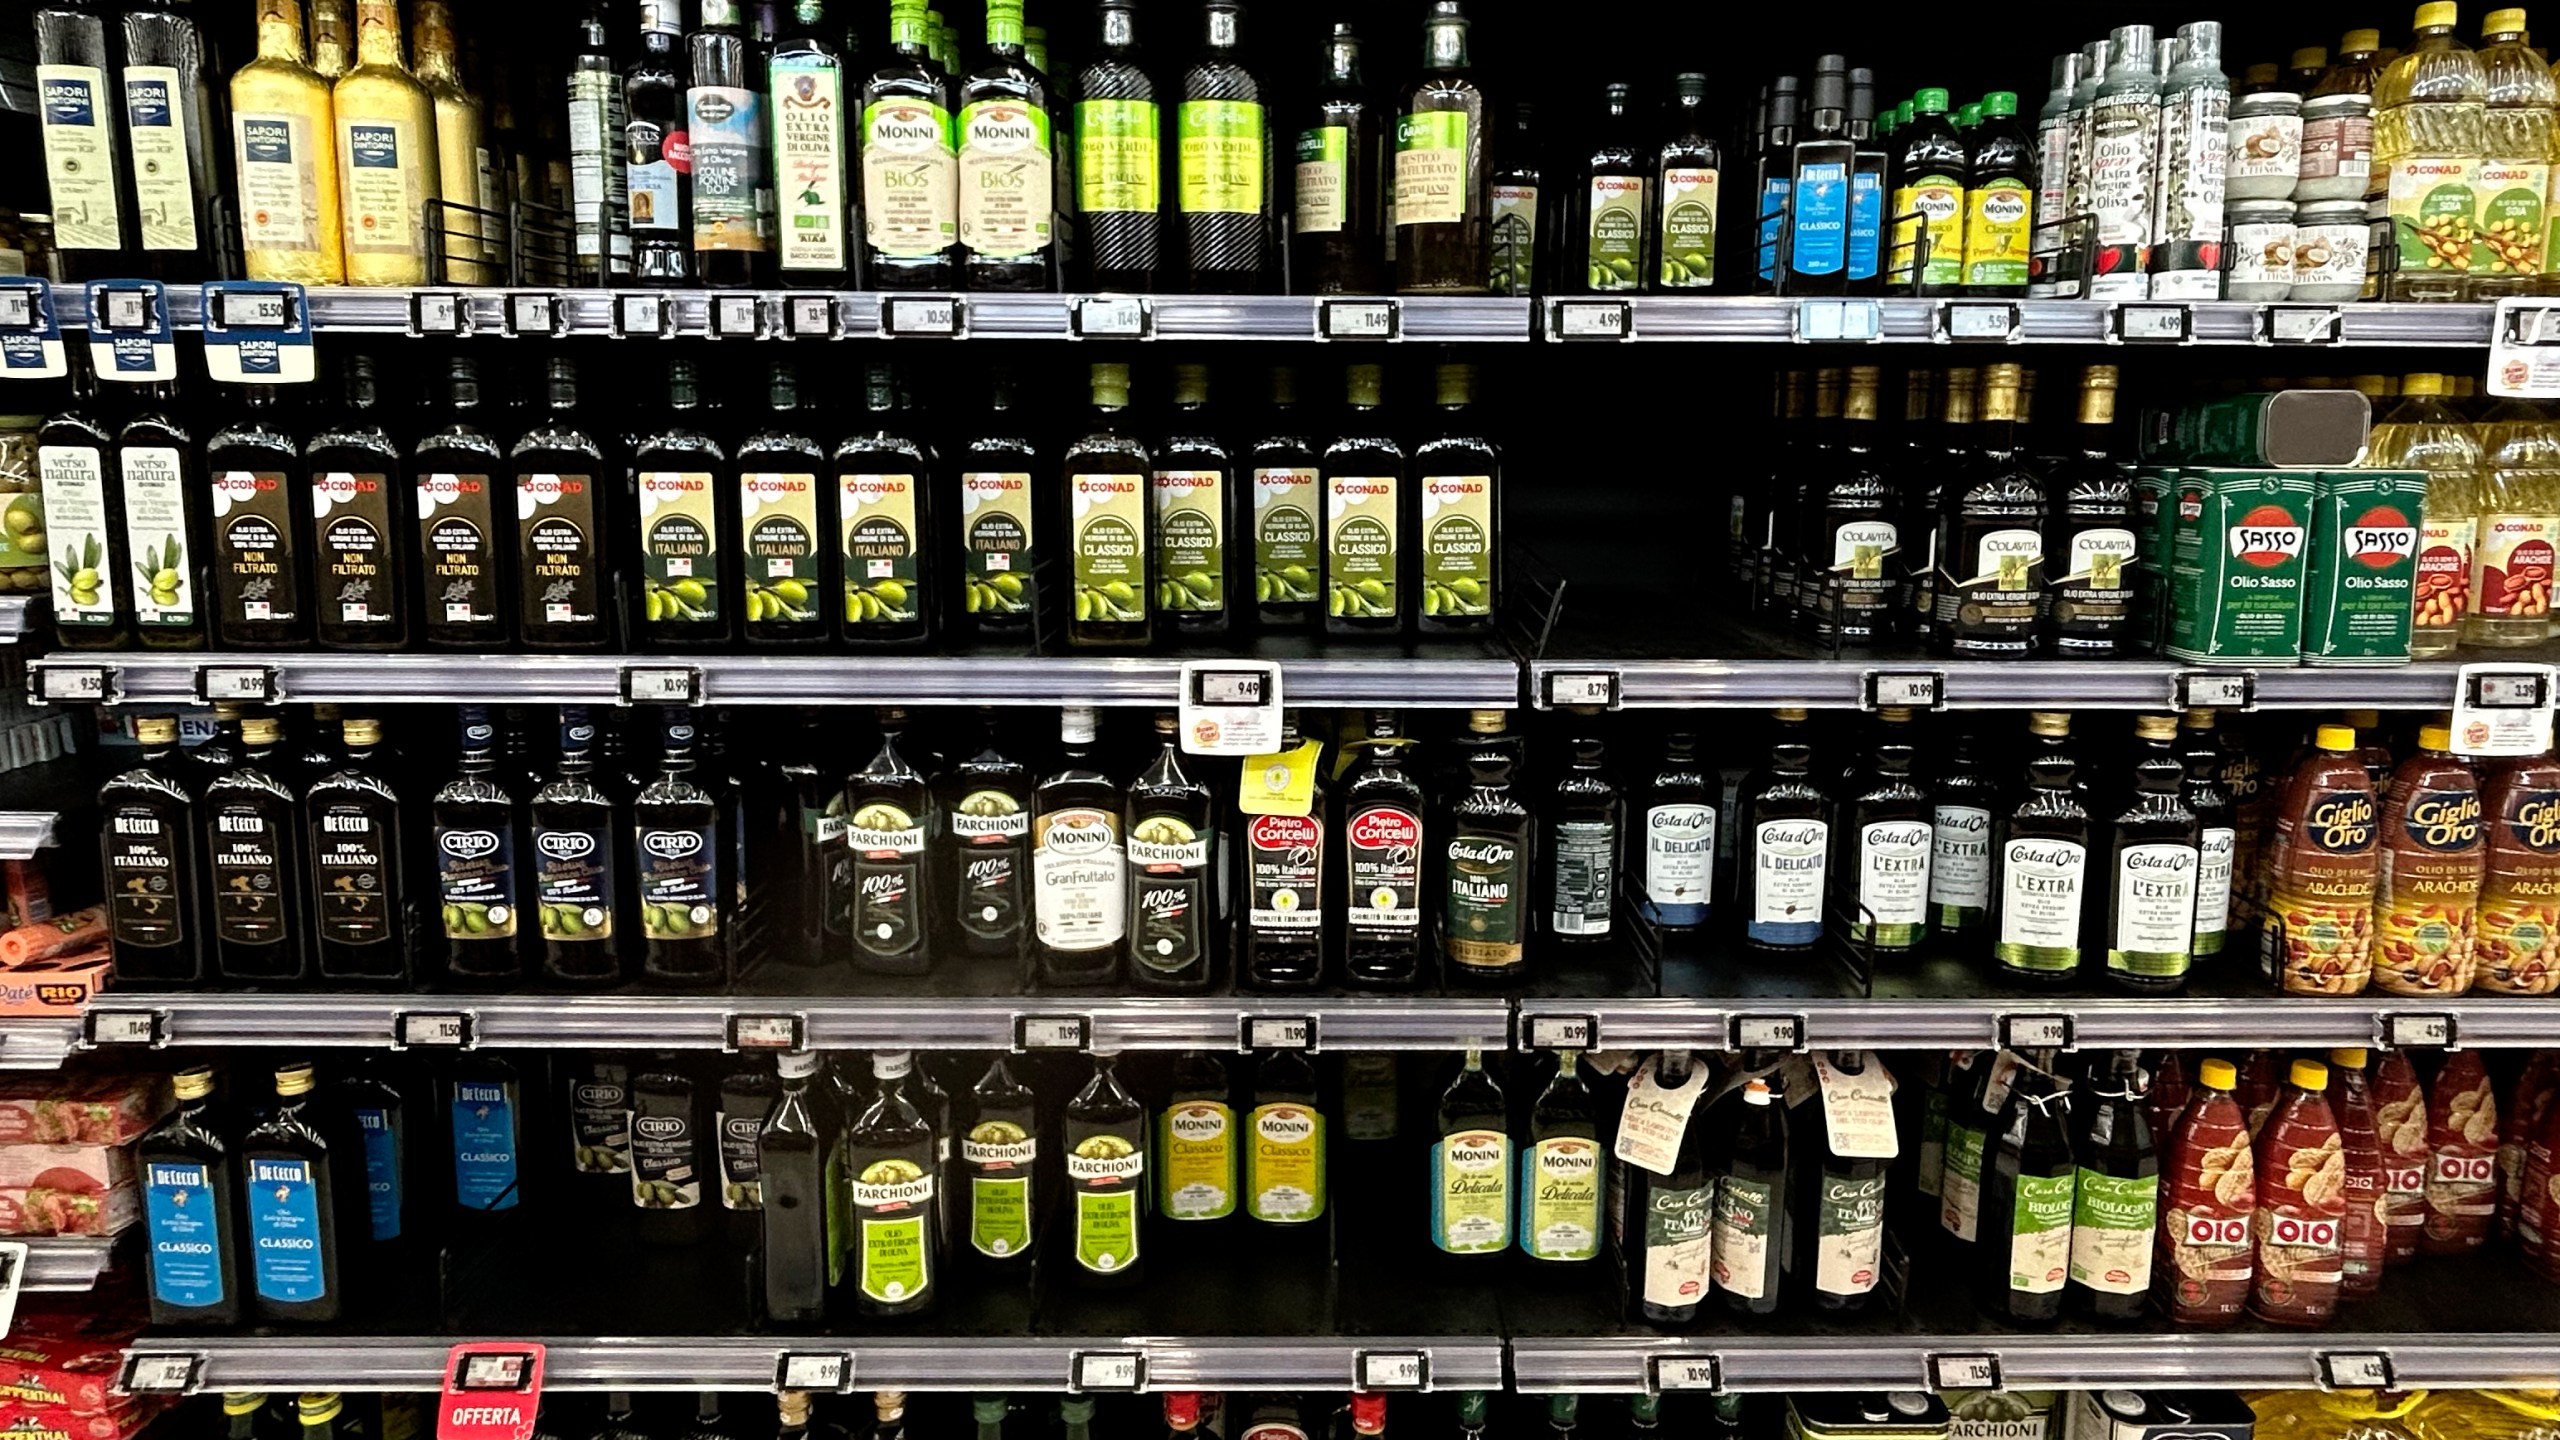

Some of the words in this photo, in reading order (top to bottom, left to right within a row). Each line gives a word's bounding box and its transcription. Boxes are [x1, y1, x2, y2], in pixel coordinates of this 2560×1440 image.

[44, 87, 88, 98] SAPORI
[128, 87, 168, 99] SAPORI
[786, 113, 829, 121] OLIO
[246, 127, 287, 137] SAPORI
[786, 123, 829, 132] EXTRA
[878, 126, 933, 138] MONINI
[974, 127, 1029, 138] MONINI
[786, 133, 829, 142] VERGINE
[787, 143, 798, 151] DI
[800, 143, 830, 152] OLIVA
[2101, 145, 2130, 156] Olio
[700, 167, 737, 176] COLLINE
[2101, 169, 2130, 179] Extra
[1915, 202, 1954, 212] MONINI
[1986, 204, 2022, 214] MONINI
[2097, 198, 2128, 209] Oliva
[2440, 202, 2461, 212] SOIA
[2505, 207, 2527, 216] SOIA
[1670, 225, 1709, 234] CLASSICO
[258, 304, 283, 317] 15.50
[926, 310, 951, 323] 10.50
[1365, 312, 1388, 328] 11.49
[1600, 314, 1620, 326] 4.99
[1988, 314, 2008, 329] 5.59
[2159, 316, 2180, 331] 4.99
[53, 459, 86, 469] verso
[133, 459, 167, 469] verso
[45, 469, 96, 481] natura
[127, 470, 176, 481] natura
[1271, 476, 1311, 484] CONAD
[658, 481, 704, 491] CONAD
[760, 482, 806, 491] CONAD
[860, 483, 905, 492] CONAD
[980, 480, 1022, 489] CONAD
[1091, 483, 1135, 492] CONAD
[1172, 478, 1214, 487] CONAD
[1441, 484, 1482, 493] CONAD
[1347, 485, 1389, 494] CONAD
[2507, 524, 2543, 532] CONAD
[1165, 537, 1212, 548] CLASSICO
[1265, 532, 1310, 543] CLASSICO
[1842, 531, 1893, 542] COLAVITA
[2240, 530, 2296, 551] SASSO
[2355, 530, 2409, 552] SASSO
[656, 544, 702, 554] ITALIANO
[757, 545, 804, 555] ITALIANO
[856, 545, 903, 556] ITALIANO
[976, 540, 1019, 550] ITALIANO
[1085, 545, 1133, 556] CLASSICO
[1339, 544, 1386, 555] CLASSICO
[1434, 543, 1481, 554] CLASSICO
[1987, 540, 2038, 551] COLAVITA
[2079, 539, 2132, 550] COLAVITA
[244, 552, 264, 561] NON
[343, 553, 363, 563] NON
[447, 554, 466, 563] NON
[547, 554, 567, 564] NON
[2514, 556, 2552, 564] ARACHIDE
[233, 563, 278, 573] FILTRATO
[332, 564, 375, 575] FILTRATO
[436, 565, 479, 575] FILTRATO
[536, 565, 580, 575] FILTRATO
[2230, 576, 2259, 588] Olio
[2260, 577, 2296, 588] Sasso
[2345, 577, 2372, 589] Olio
[2374, 577, 2408, 589] Sasso
[81, 678, 102, 690] 9.50
[240, 678, 264, 690] 10.99
[664, 679, 688, 692] 10.99
[1238, 682, 1259, 695] 9.49
[1587, 683, 1608, 696] 8.79
[1909, 684, 1932, 697] 10.99
[2223, 685, 2242, 698] 9.29
[2515, 685, 2534, 698] 3.39
[2315, 798, 2372, 827] Giglio
[2414, 797, 2481, 825] Giglio
[957, 817, 1024, 830] FARCHIONI
[1269, 817, 1302, 827] Pietro
[1369, 816, 1401, 827] Pietro
[1652, 812, 1681, 828] Costa
[1682, 813, 1712, 829] d'Oro
[1052, 832, 1105, 845] MONINI
[1257, 827, 1314, 840] Coricelli
[1356, 826, 1413, 839] Coricelli
[1762, 828, 1792, 844] Costa
[1794, 828, 1824, 844] d'Oro
[1868, 829, 1899, 845] Costa
[1901, 829, 1930, 846] d'Oro
[2324, 827, 2366, 848] Oro
[2425, 825, 2476, 845] Oro
[446, 836, 492, 848] CIRIO
[543, 837, 587, 849] CIRIO
[648, 836, 696, 848] CIRIO
[851, 832, 917, 846] FARCHIONI
[1652, 837, 1661, 852] IL
[1665, 838, 1710, 853] DELICATO
[129, 845, 157, 855] 100%
[232, 843, 260, 852] 100%
[336, 843, 366, 852] 100%
[1132, 844, 1199, 859] FARCHIONI
[114, 856, 168, 867] ITALIANO
[218, 854, 272, 864] ITALIANO
[322, 854, 377, 864] ITALIANO
[1761, 853, 1771, 868] IL
[1775, 854, 1822, 870] DELICATO
[2010, 845, 2049, 862] Costa
[2046, 848, 2081, 866] d'Oro
[2127, 851, 2162, 870] Costa
[2163, 853, 2194, 871] d'Oro
[1256, 864, 1280, 874] 100%
[1282, 864, 1316, 875] Italiano
[1355, 863, 1378, 873] 100%
[1381, 863, 1414, 873] Italiano
[1874, 856, 1924, 871] L'EXTRA
[1453, 879, 1507, 898] ITALIANO
[2016, 873, 2074, 893] L'EXTRA
[2133, 880, 2188, 897] L'EXTRA
[2305, 882, 2370, 896] ARACHIDE
[2413, 880, 2479, 893] ARACHIDE
[41, 987, 83, 999] RIO
[129, 1022, 149, 1035] 11.49
[439, 1024, 460, 1037] 11.50
[771, 1025, 792, 1036] 9.99
[1059, 1027, 1079, 1039] 11.99
[1285, 1027, 1305, 1040] 11.90
[1564, 1026, 1586, 1039] 10.99
[1774, 1026, 1793, 1039] 9.90
[2043, 1026, 2063, 1039] 9.90
[582, 1089, 618, 1100] CIRIO
[641, 1122, 679, 1133] CIRIO
[1175, 1119, 1222, 1131] MONINI
[1262, 1121, 1309, 1132] MONINI
[967, 1145, 1031, 1158] FARCHIONI
[1173, 1143, 1223, 1155] Classico
[1261, 1144, 1310, 1156] Classico
[1451, 1150, 1499, 1162] MONINI
[1073, 1159, 1137, 1173] FARCHIONI
[1543, 1157, 1592, 1168] MONINI
[2441, 1158, 2490, 1178] OIO
[858, 1184, 927, 1199] FARCHIONI
[2087, 1196, 2154, 1213] BIOLOGICO
[2191, 1220, 2244, 1242] OIO
[158, 1241, 212, 1254] CLASSICO
[260, 1237, 314, 1250] CLASSICO
[820, 1365, 838, 1379] 9.99
[1115, 1364, 1134, 1377] 9.99
[1400, 1364, 1418, 1377] 9.99
[1687, 1368, 1710, 1381] 10.90
[1969, 1366, 1990, 1379] 11.50
[452, 1408, 521, 1425] OFFERTA
